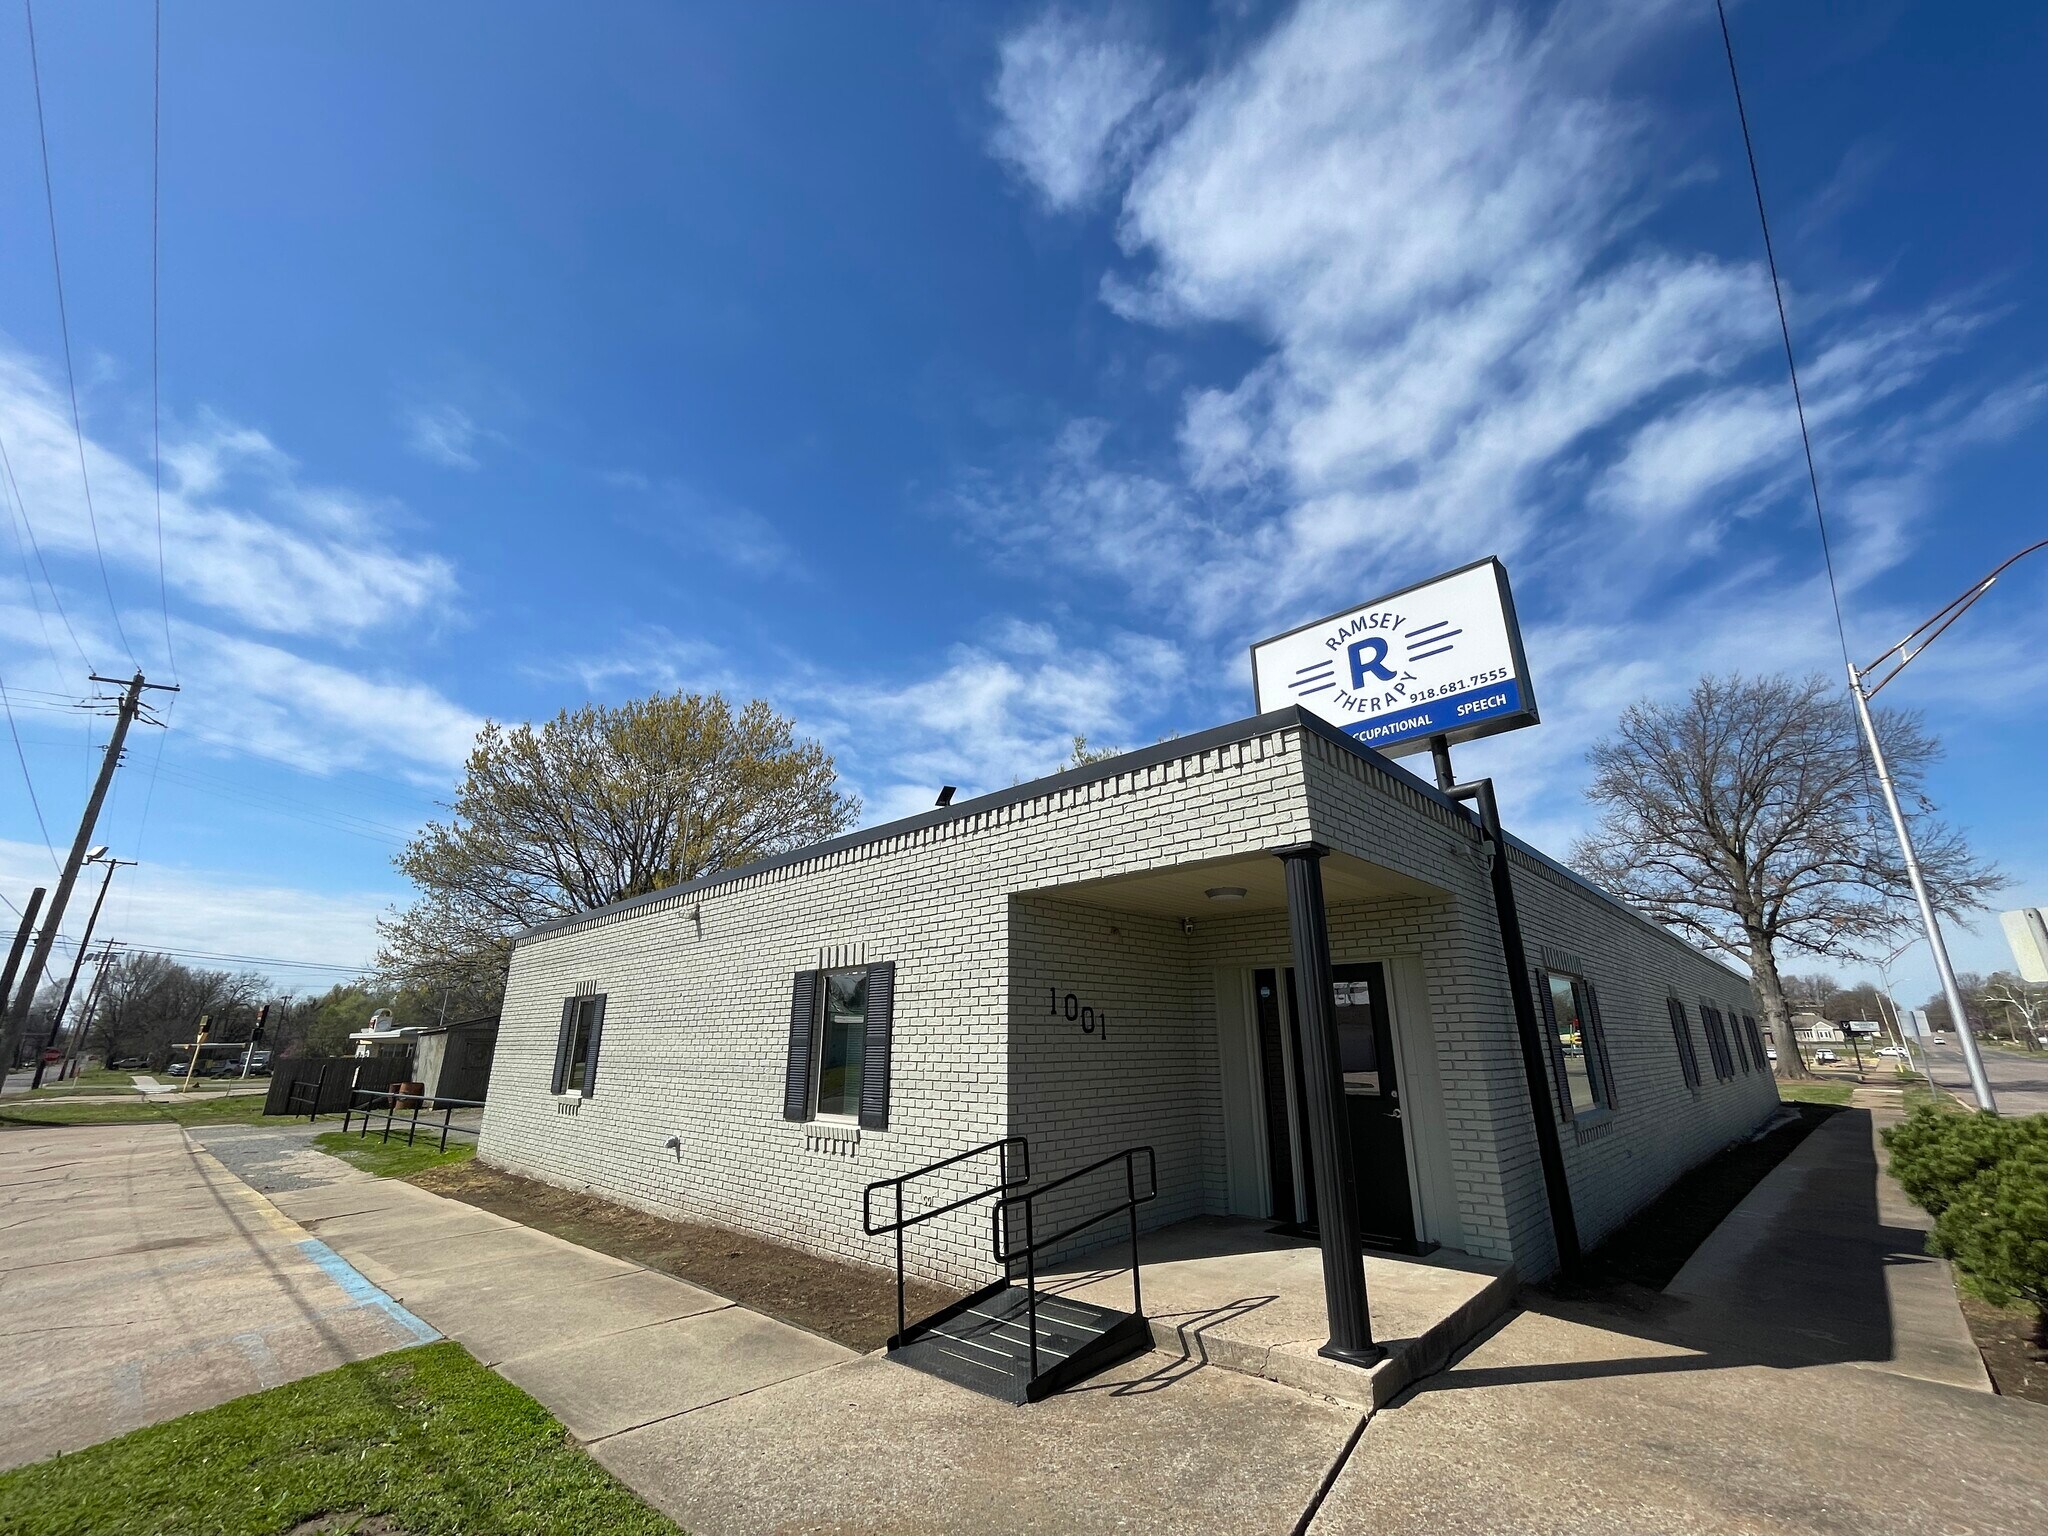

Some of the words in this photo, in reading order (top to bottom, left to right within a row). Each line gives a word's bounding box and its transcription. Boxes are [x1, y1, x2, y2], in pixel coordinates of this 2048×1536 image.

[1325, 612, 1406, 651] RAMSEY
[1347, 637, 1397, 690] R
[1409, 667, 1507, 703] 918.681.7555
[1333, 671, 1417, 713] THERAPY
[1352, 714, 1433, 742] CUPATIONAL
[1456, 693, 1507, 717] SPEECH
[1050, 987, 1106, 1040] 1001
